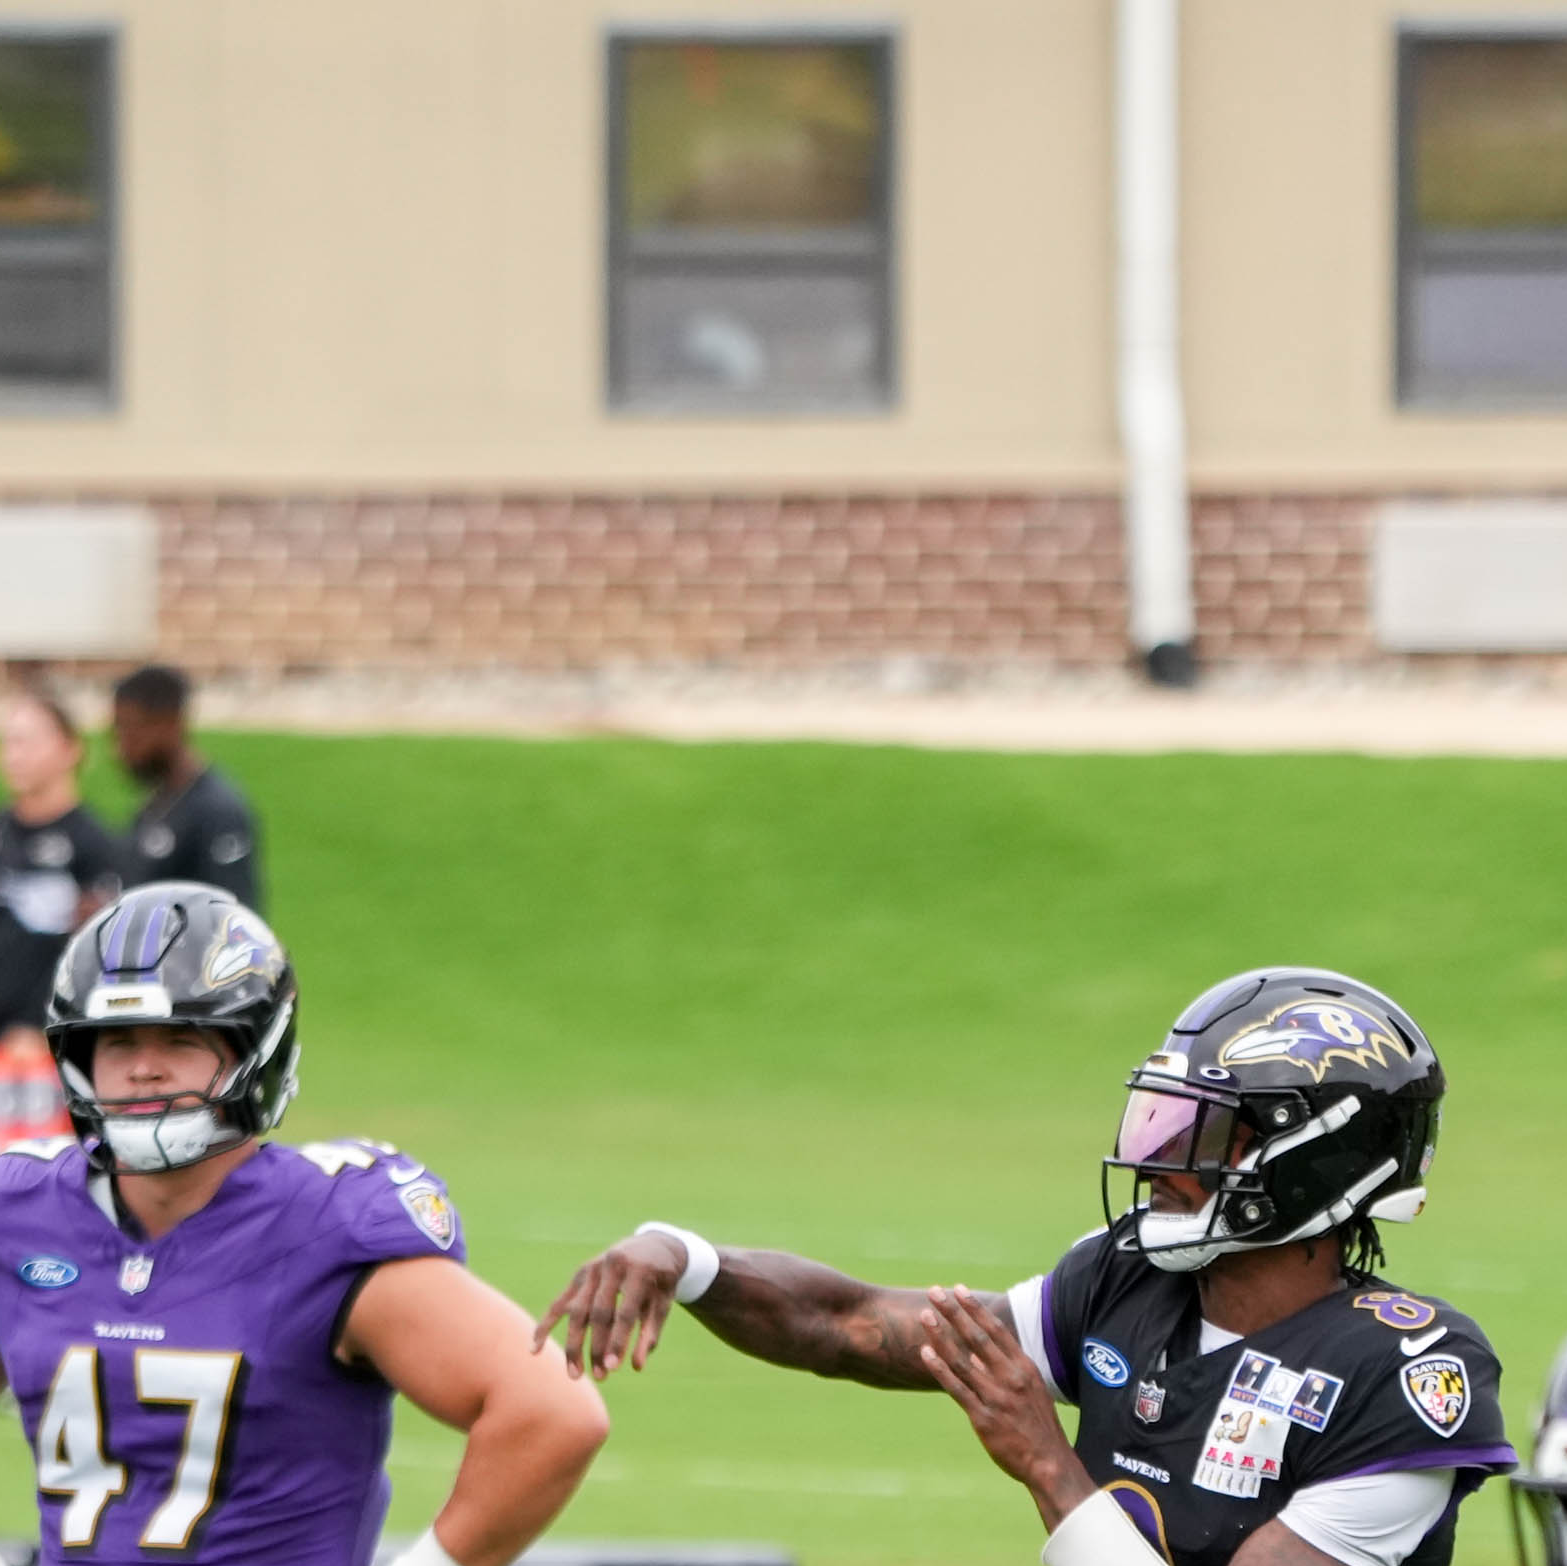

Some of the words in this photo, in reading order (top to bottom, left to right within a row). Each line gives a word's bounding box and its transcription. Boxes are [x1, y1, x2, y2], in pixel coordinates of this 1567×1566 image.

[30, 1261, 67, 1283] Ford
[94, 1322, 166, 1341] RAVENS
[1087, 1347, 1121, 1380] Ford
[1408, 1361, 1460, 1377] RAVENS
[1292, 1408, 1321, 1426] MVP
[38, 1346, 244, 1549] 47
[1113, 1452, 1171, 1484] RAVENS
